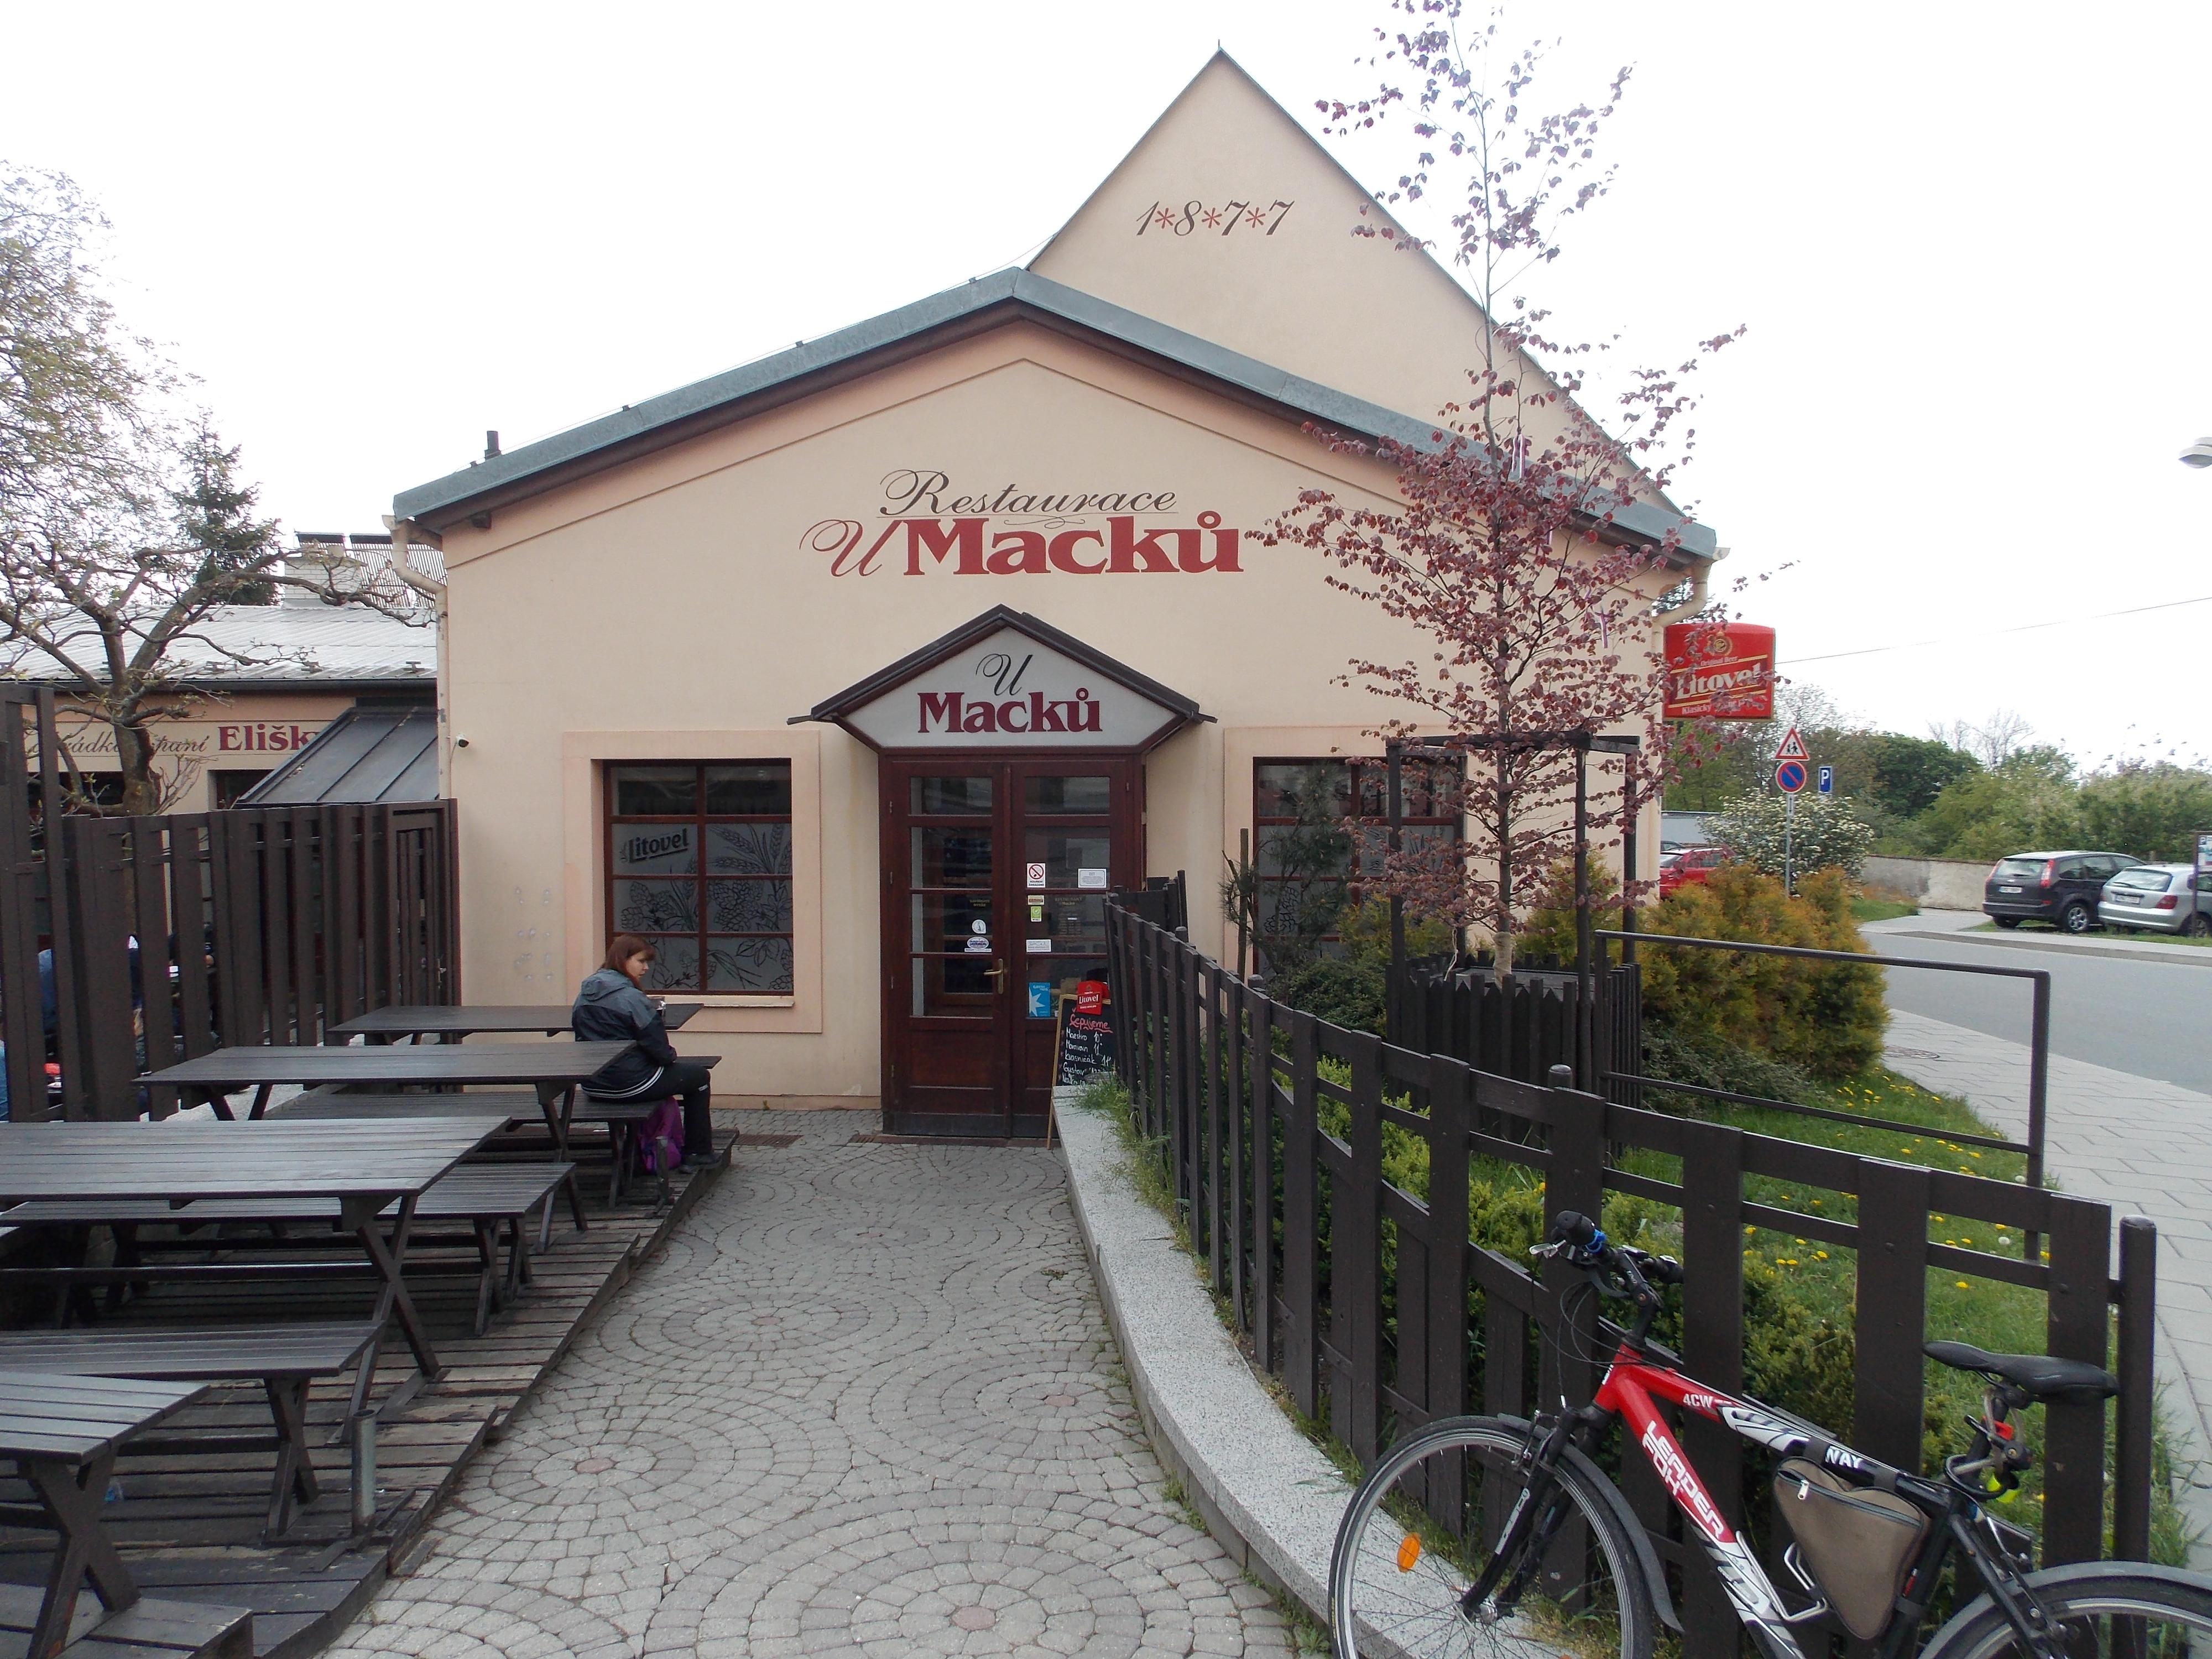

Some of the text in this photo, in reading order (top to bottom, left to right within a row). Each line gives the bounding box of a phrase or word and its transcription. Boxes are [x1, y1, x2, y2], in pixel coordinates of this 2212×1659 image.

[880, 469, 1177, 516] Restaurace
[799, 511, 1244, 577] U Macků
[975, 653, 1033, 696] U
[1674, 662, 1762, 700] Litovel
[917, 687, 1102, 733] Macků
[218, 723, 321, 751] Elišk
[1821, 769, 1829, 785] P
[628, 828, 690, 863] Litovel
[1079, 994, 1099, 1004] Litovel
[1066, 1026, 1088, 1041] Maestro
[1070, 1008, 1110, 1030] Čepujeme
[1642, 1433, 1681, 1496] FOX
[1647, 1420, 1724, 1539] LEADER
